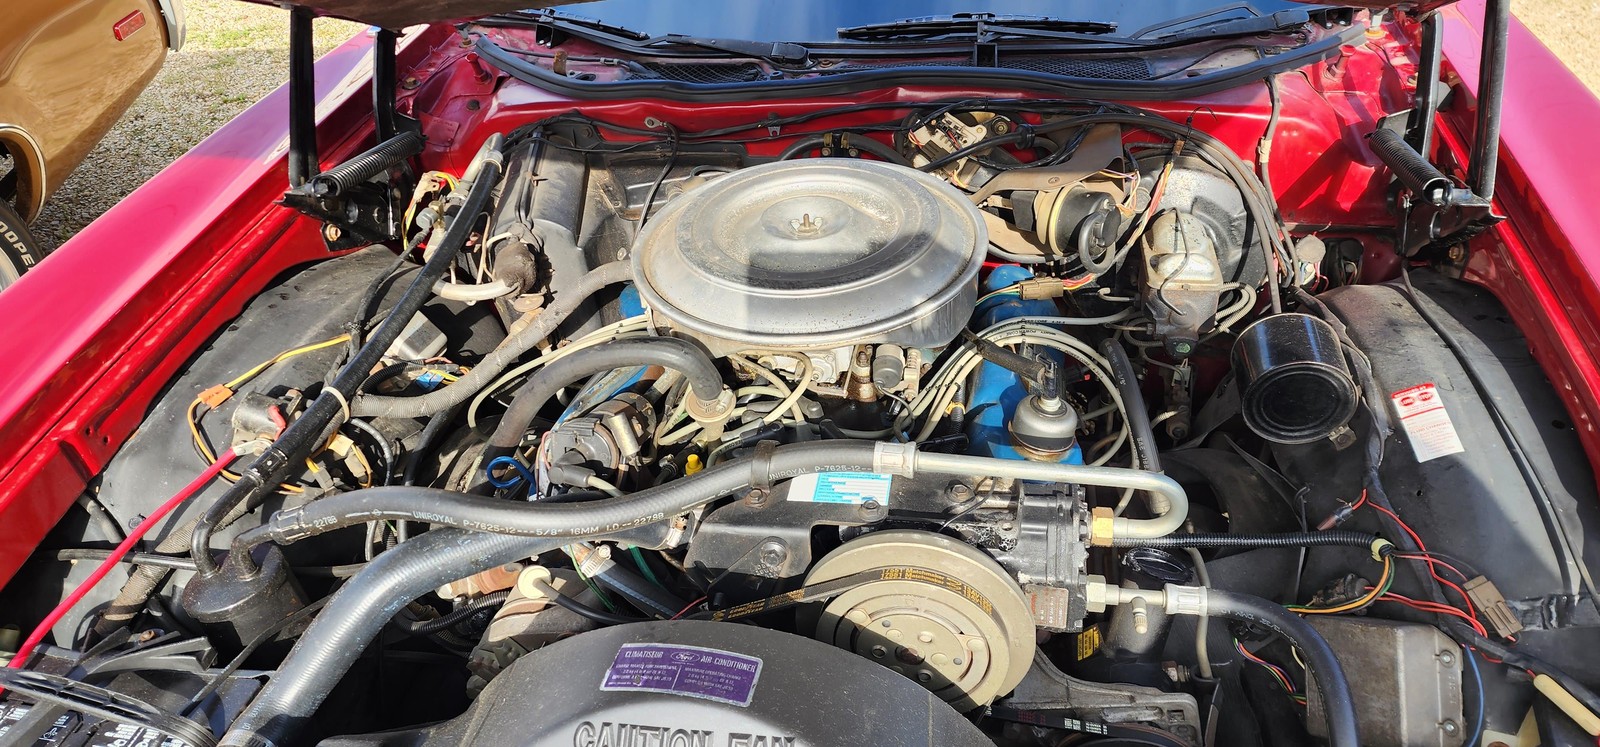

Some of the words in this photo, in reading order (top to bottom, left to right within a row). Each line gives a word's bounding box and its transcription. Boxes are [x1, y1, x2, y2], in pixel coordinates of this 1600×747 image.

[0, 220, 35, 268] OOPE
[412, 511, 458, 526] UNIROYAL
[570, 526, 600, 535] 16MM
[700, 655, 713, 664] AIR
[714, 658, 757, 673] CONDITIONER
